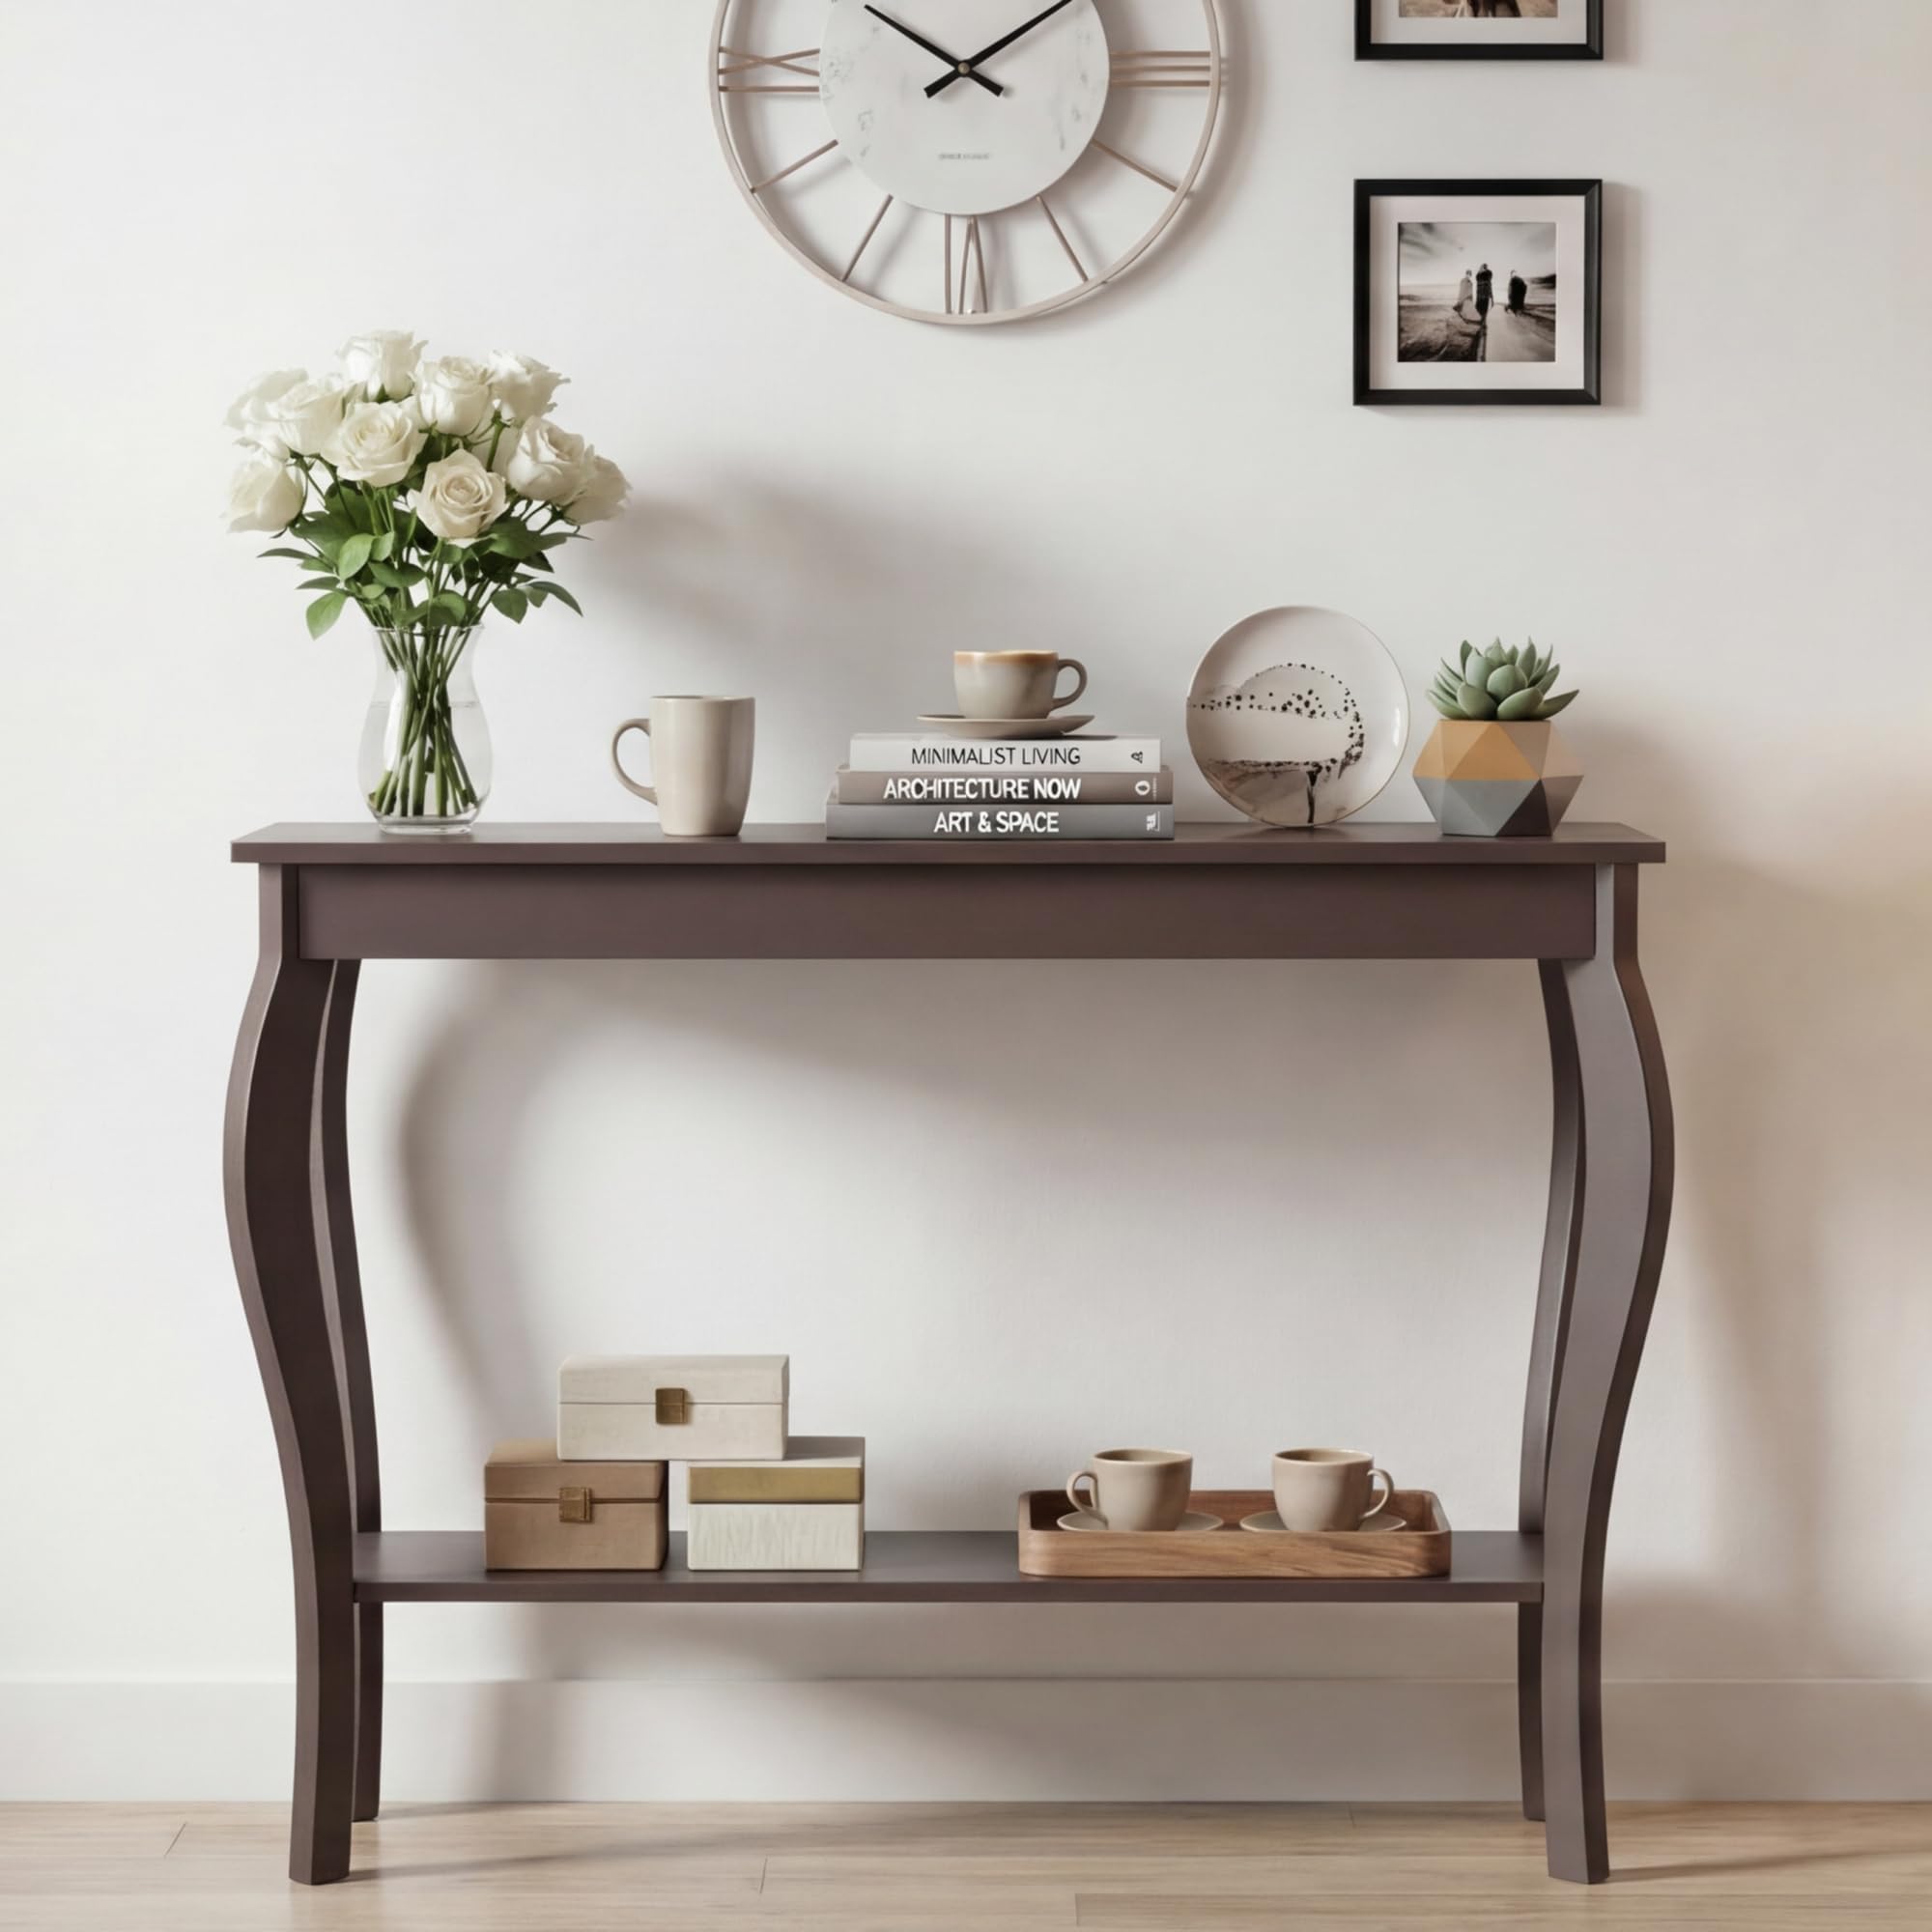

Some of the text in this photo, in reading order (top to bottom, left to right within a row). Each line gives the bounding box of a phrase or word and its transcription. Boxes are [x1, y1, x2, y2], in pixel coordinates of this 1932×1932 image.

[911, 748, 1081, 765] MINIMALIST LIVING
[883, 779, 1082, 800] ARCHITECTURE NOW
[933, 811, 1060, 834] ART & SPACE
